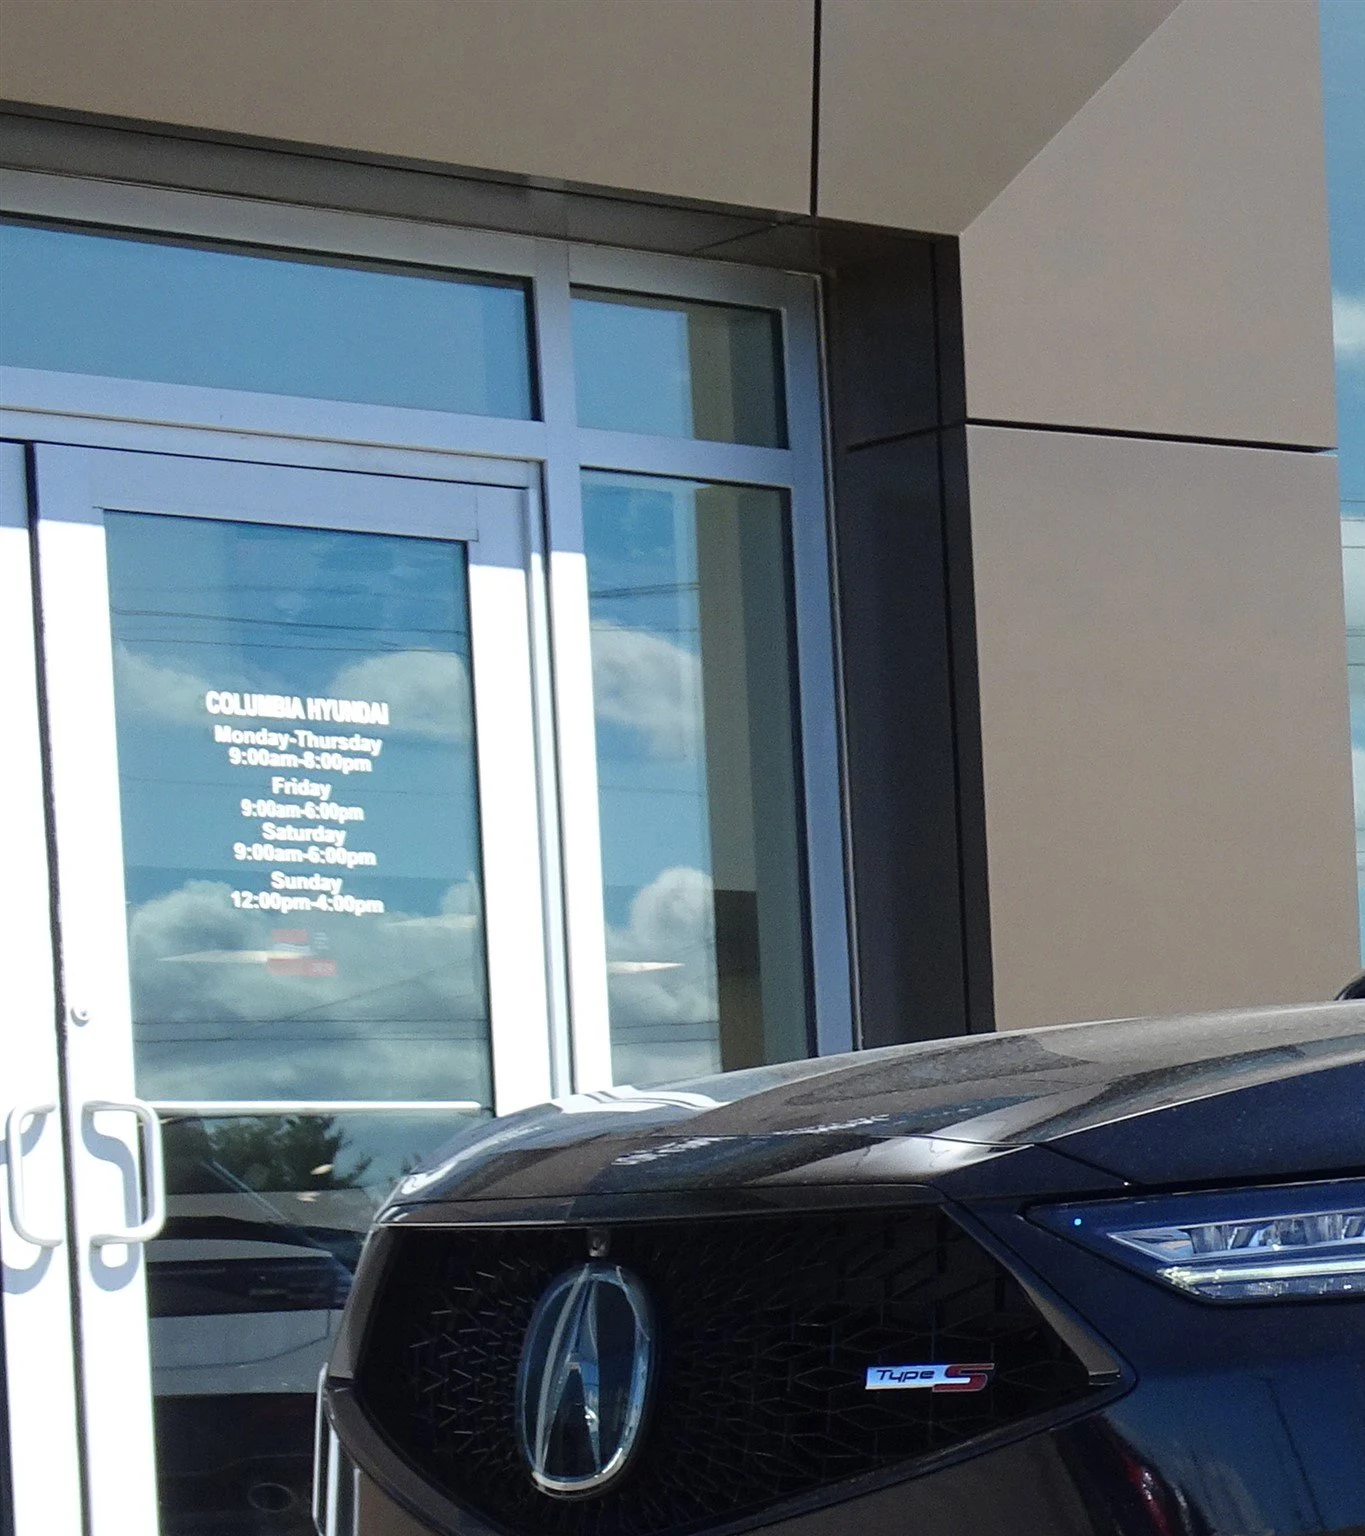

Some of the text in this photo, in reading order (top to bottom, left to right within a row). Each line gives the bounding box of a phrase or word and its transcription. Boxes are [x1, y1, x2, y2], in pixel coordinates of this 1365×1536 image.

[205, 690, 389, 726] COLUMBIA HYUNDAI
[214, 725, 382, 757] Monday-Thursday
[228, 747, 372, 775] 9:00am-8:00pm
[271, 776, 331, 800] Friday
[240, 798, 364, 824] 9:00am-6:00pm
[262, 822, 345, 847] Saturday
[270, 871, 342, 895] Sunday
[230, 890, 384, 917] 12:00pm-4:00pm
[876, 1362, 995, 1393] Type S
